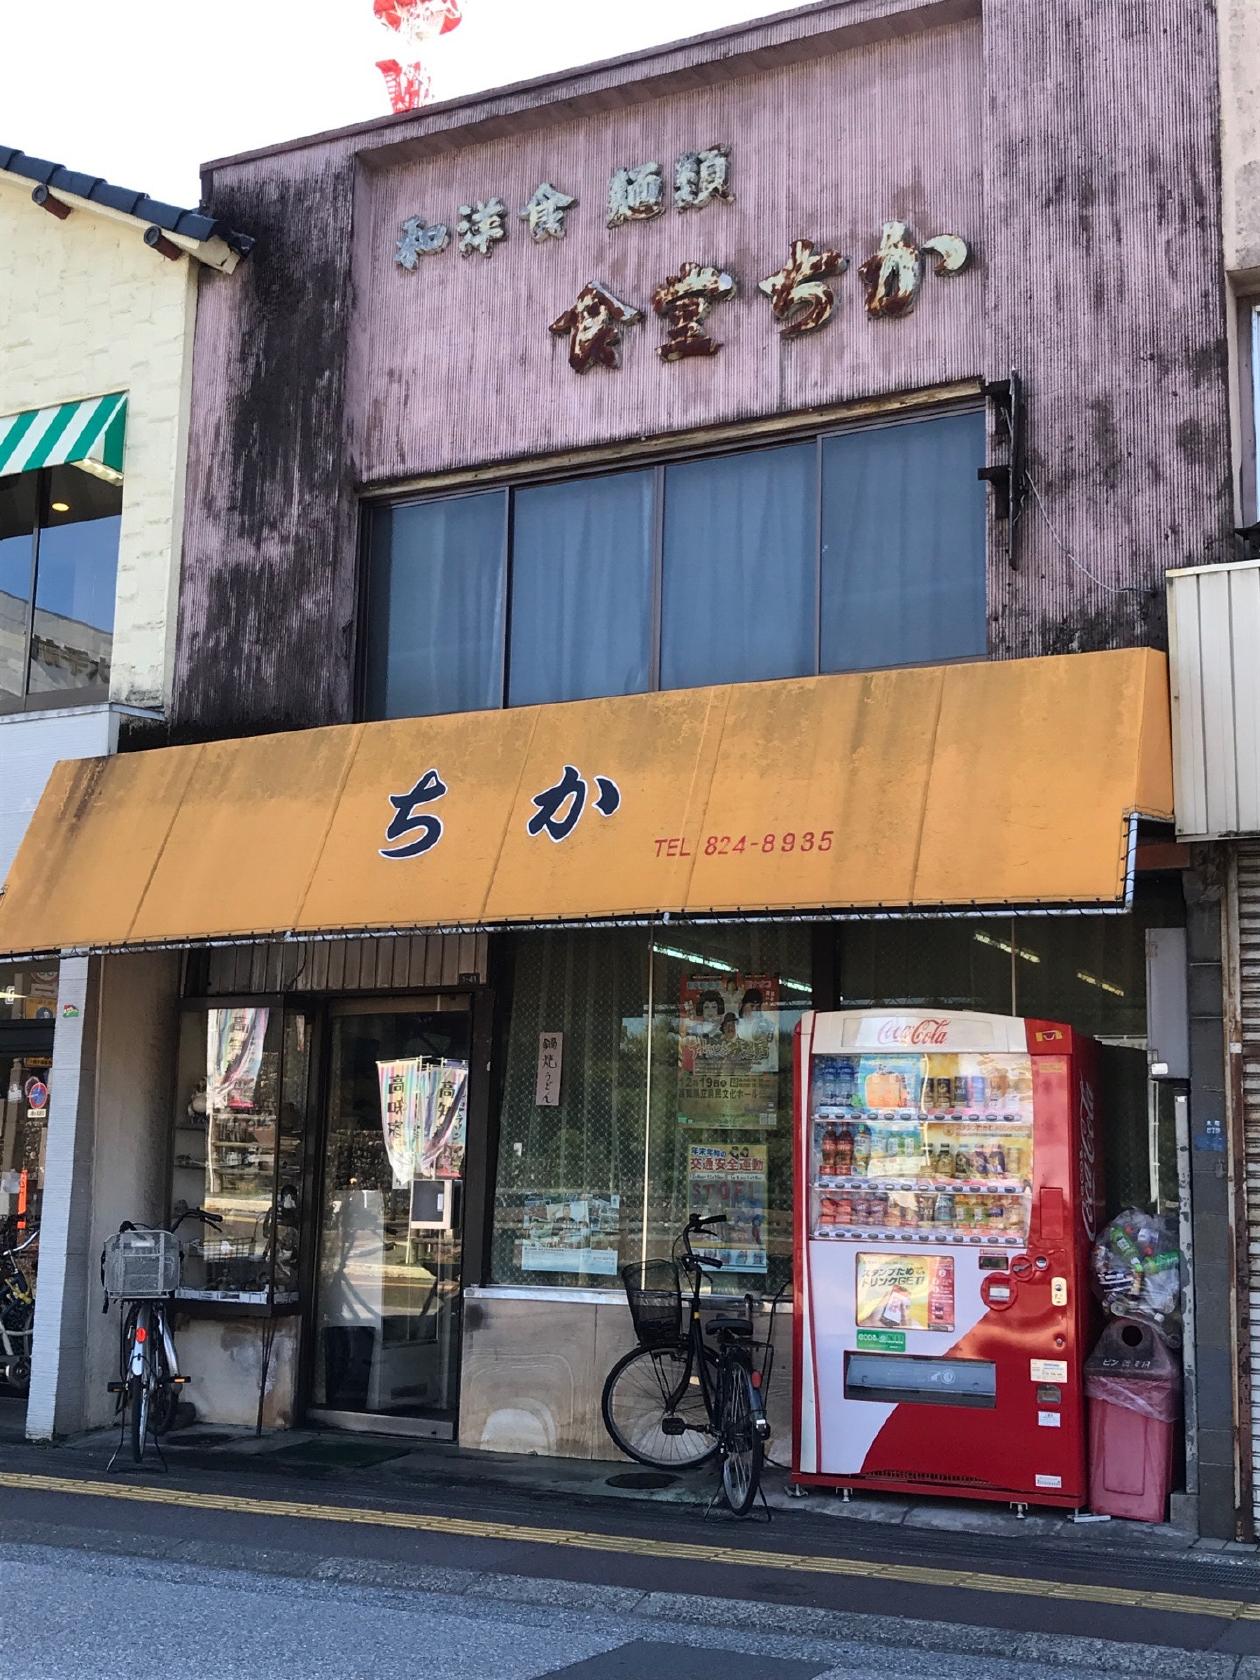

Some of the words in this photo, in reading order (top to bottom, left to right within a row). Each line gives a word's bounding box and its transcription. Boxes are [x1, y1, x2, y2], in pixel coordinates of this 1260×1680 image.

[395, 182, 579, 272] 和洋食
[378, 764, 622, 859] ちか
[654, 838, 692, 858] TEL
[704, 831, 835, 856] 824-8935
[542, 1037, 558, 1104] 鍋焼うどん
[690, 1157, 764, 1172] 交通安全運動
